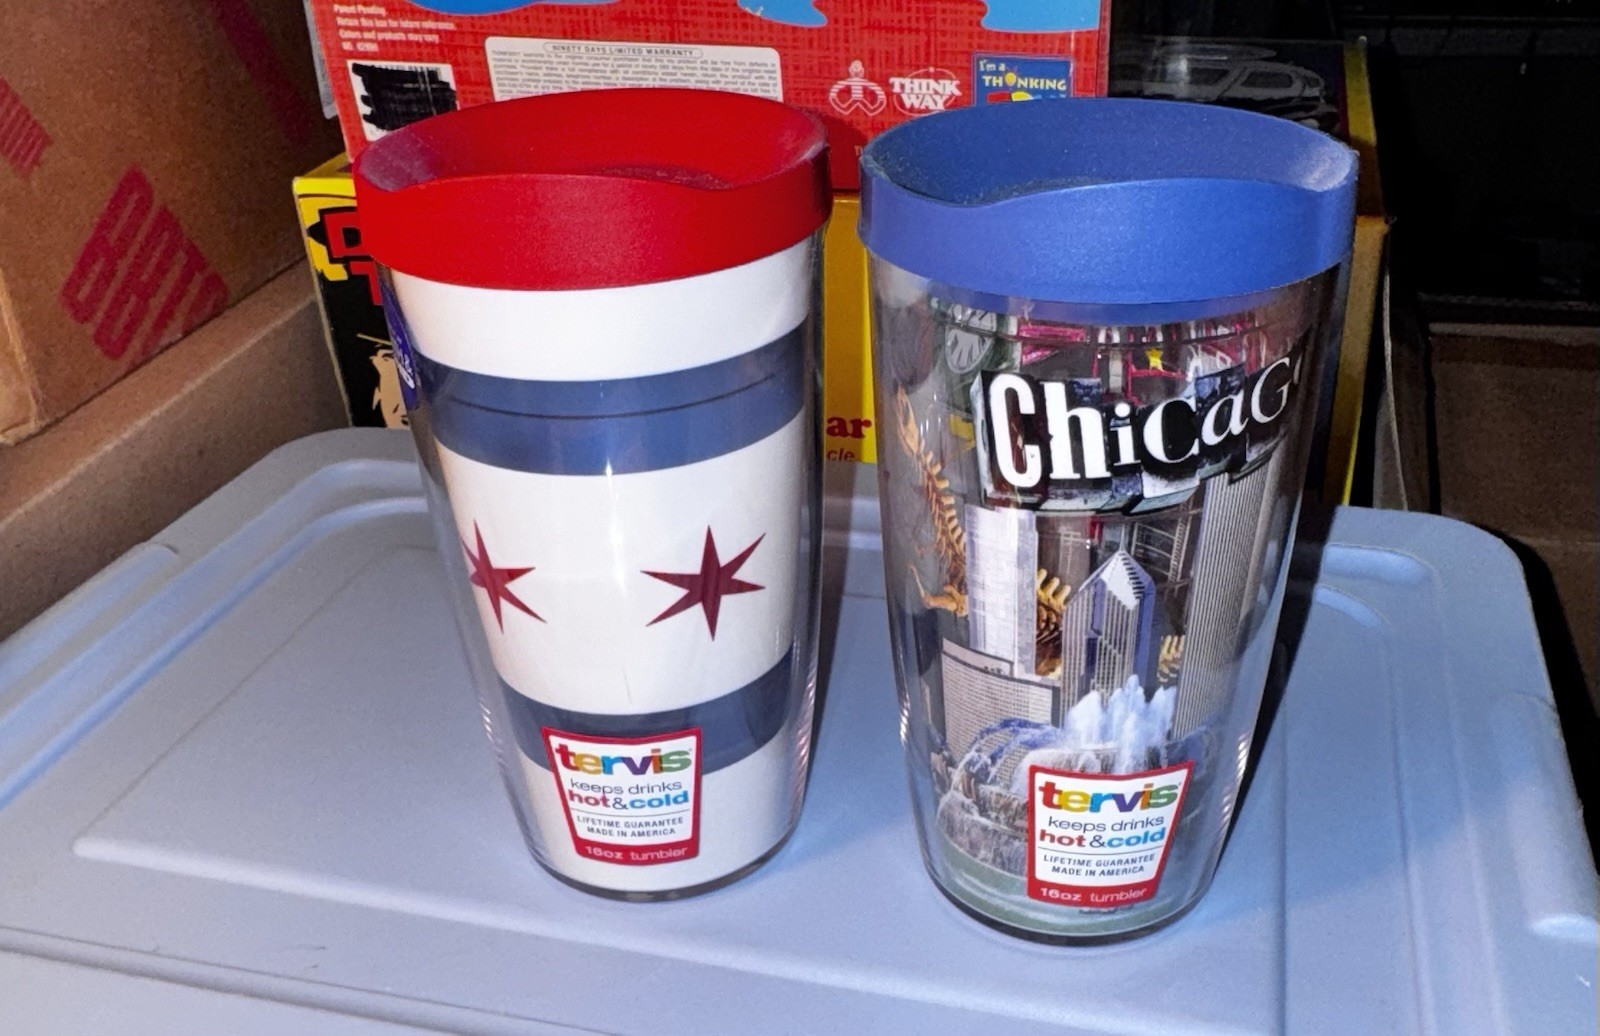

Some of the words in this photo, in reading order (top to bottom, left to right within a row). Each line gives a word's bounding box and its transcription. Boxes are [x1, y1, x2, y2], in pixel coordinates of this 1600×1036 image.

[552, 44, 581, 53] NINETY
[584, 45, 607, 54] DAYS
[609, 46, 643, 55] LIMITED
[646, 48, 694, 56] WARRANTY
[979, 59, 998, 72] I'm
[998, 63, 1006, 72] a
[889, 77, 962, 96] THINK
[901, 93, 951, 111] WAY
[555, 743, 692, 775] tervis
[570, 778, 624, 795] keeps
[628, 780, 683, 795] drinks
[1038, 780, 1180, 813] tervis
[577, 815, 621, 828] LIFETIME
[624, 816, 684, 828] GUARANTEE
[1048, 816, 1106, 834] keeps
[1110, 815, 1164, 832] drinks
[587, 826, 615, 837] MADE
[616, 830, 628, 838] IN
[630, 828, 676, 838] AMERICA
[585, 845, 624, 860] 16oz
[630, 847, 688, 861] tumbler
[1043, 854, 1092, 867] LIFETIME
[1095, 853, 1156, 867] GUARANTEE
[1051, 865, 1082, 876] MADE
[1098, 865, 1145, 877] AMERICA
[1039, 886, 1082, 901] 16oz
[1089, 888, 1148, 903] tumbler
